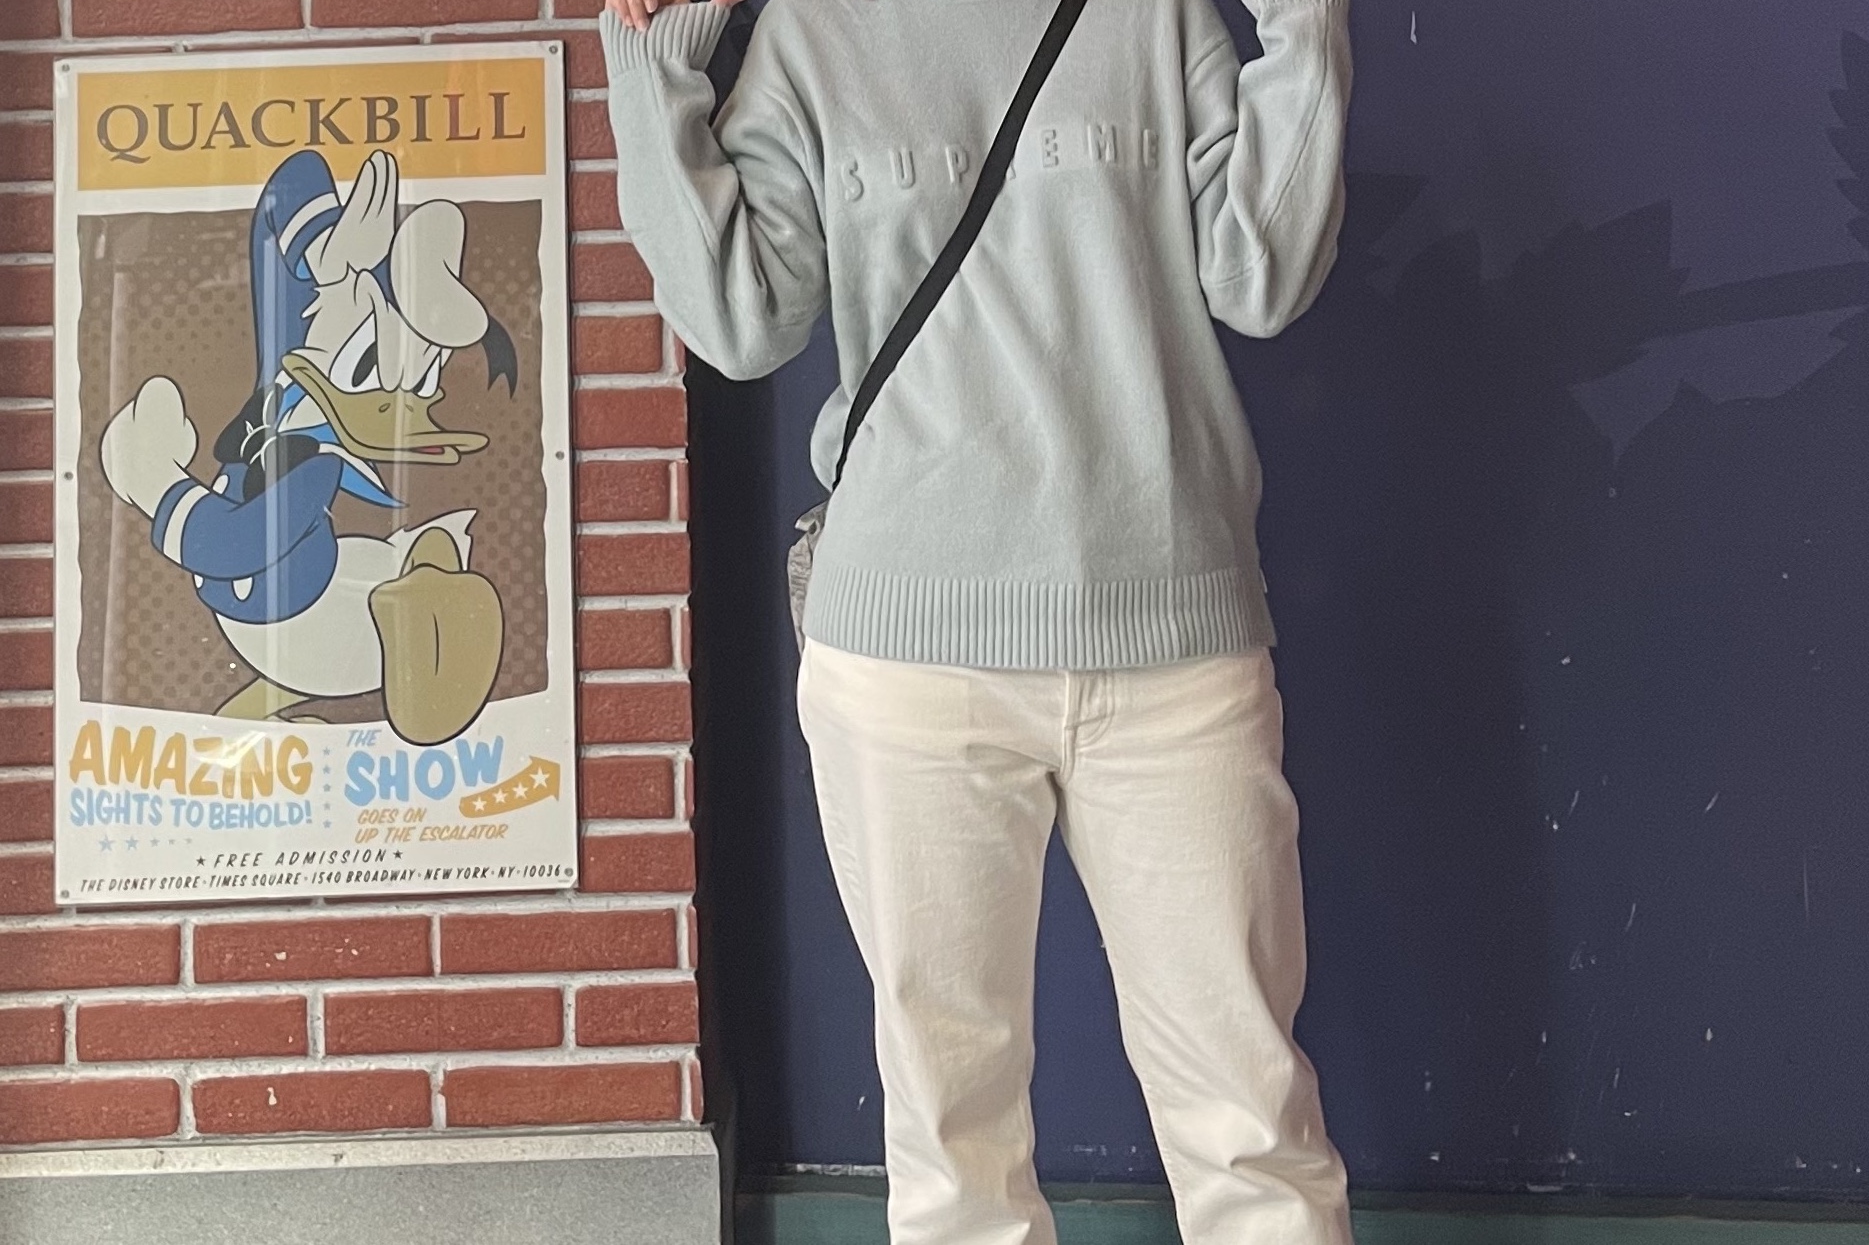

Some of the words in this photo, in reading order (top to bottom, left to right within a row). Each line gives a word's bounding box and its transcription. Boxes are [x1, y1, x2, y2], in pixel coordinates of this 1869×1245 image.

[96, 91, 526, 164] QUACKBILL
[840, 123, 1160, 202] SUPEME
[346, 730, 382, 747] THE
[69, 720, 313, 799] AMAZING
[344, 735, 504, 807] SHOW
[70, 787, 164, 827] SIGHTS
[170, 799, 204, 827] TO
[208, 800, 313, 830] BEHOLD!
[357, 809, 398, 825] GOES
[403, 808, 428, 823] ON
[355, 828, 379, 844] UP
[384, 827, 417, 843] THE
[419, 824, 508, 841] ESCALATOR
[213, 853, 263, 868] FREE
[274, 849, 386, 866] ADMISSION
[80, 879, 105, 892] THE
[108, 877, 157, 891] DISNEY
[159, 875, 201, 889] STORE
[209, 874, 248, 888] TIMES
[251, 872, 305, 887] SQUARE
[312, 870, 341, 885] 1540
[345, 869, 415, 883] BROADWAY
[424, 868, 453, 881] NEW
[456, 867, 488, 880] YORK
[497, 866, 516, 878] NY
[523, 864, 561, 878] 10036
